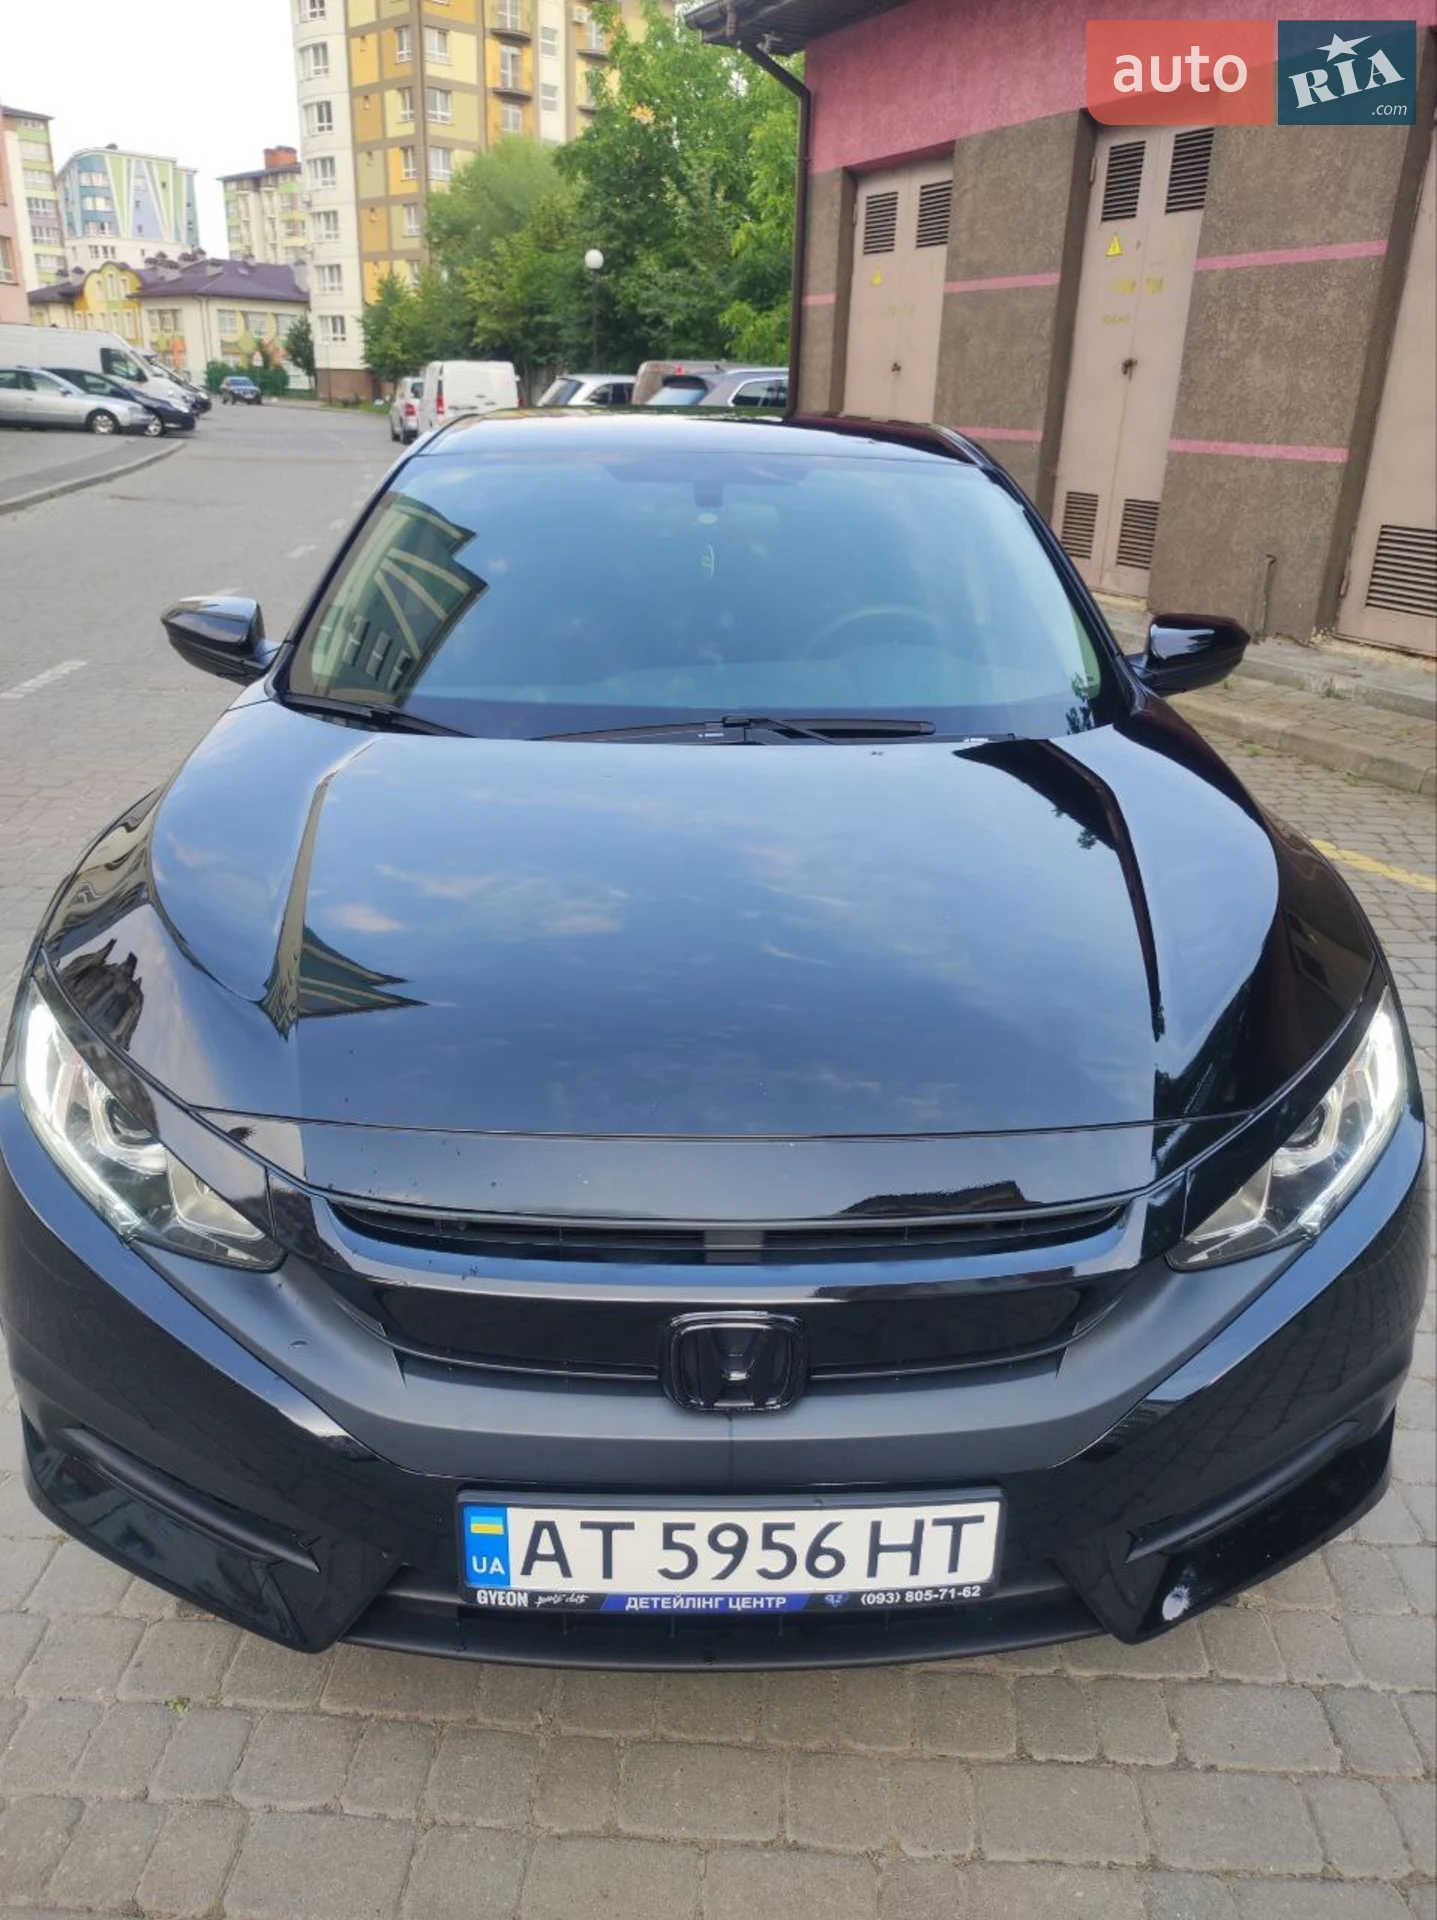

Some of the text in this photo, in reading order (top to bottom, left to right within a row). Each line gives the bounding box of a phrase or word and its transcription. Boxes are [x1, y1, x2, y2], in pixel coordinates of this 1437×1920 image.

[520, 1514, 985, 1581] AT 5956 HT
[472, 1555, 506, 1575] UA
[476, 1589, 529, 1608] GYEON
[625, 1592, 787, 1611] ДЕТЕЙЛІНГ ЦЕНТР
[860, 1585, 981, 1606] (093) 805-71-62
